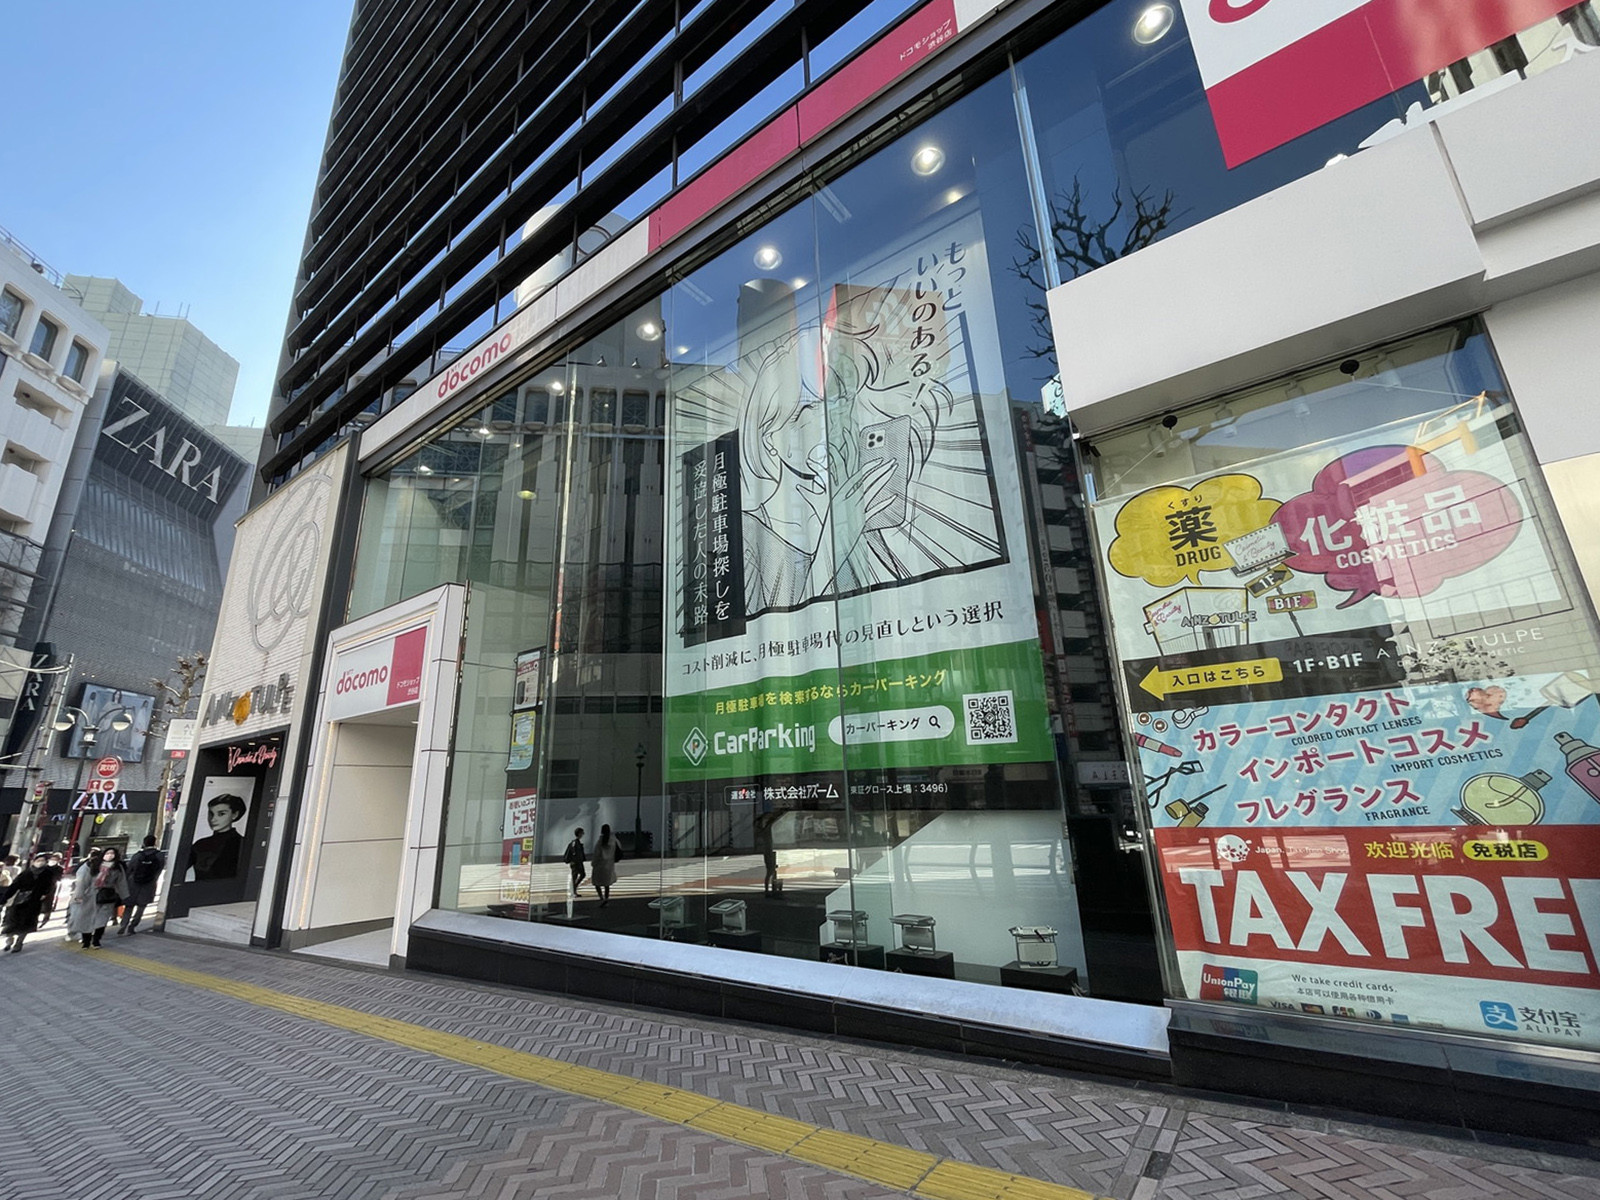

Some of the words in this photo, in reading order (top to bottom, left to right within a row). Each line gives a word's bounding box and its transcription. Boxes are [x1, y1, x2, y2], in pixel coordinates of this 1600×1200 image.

[900, 18, 951, 61] ドコモショップ
[943, 242, 966, 311] もっと
[437, 333, 512, 398] docomo
[102, 396, 221, 504] ZARA
[1168, 494, 1203, 510] くすり
[1165, 505, 1218, 551] 薬
[1300, 484, 1482, 555] 化粧品
[693, 459, 708, 626] 妥協した人の末路
[711, 451, 730, 621] 月極駐車場探しを
[1175, 545, 1221, 567] DRUG
[1336, 533, 1458, 569] COSMETICS
[1259, 573, 1275, 589] 1F
[1273, 595, 1301, 610] B1F
[1181, 614, 1210, 628] AINZ
[1219, 609, 1258, 624] TULPE
[1466, 627, 1544, 648] TULPE
[20, 654, 49, 711] ZARA
[336, 665, 388, 695] docomo
[1172, 665, 1265, 687] 入口はこちら
[846, 717, 920, 735] カーパーキング
[1193, 692, 1410, 752] カラーコンタクト
[1291, 728, 1333, 746] COLORED
[1335, 723, 1379, 739] CONTACT
[1382, 716, 1422, 731] LENSES
[714, 722, 816, 753] CarParking
[1239, 721, 1489, 782] インポートコスメ
[1391, 758, 1434, 773] IMPORT
[1437, 748, 1503, 766] COSMETICS
[72, 791, 128, 810] ZARA
[763, 784, 839, 800] 株式会社アズーム
[1237, 780, 1420, 823] フレグランス
[1365, 805, 1431, 821] FRAGRANCE
[1364, 841, 1455, 859] 欢迎光临
[1471, 842, 1538, 859] 免税店
[1179, 868, 1371, 957] TAX
[1203, 972, 1255, 993] UnionPay
[1292, 974, 1307, 983] We
[1310, 976, 1331, 986] take
[1333, 979, 1363, 990] credit
[1366, 982, 1398, 993] cards.
[1270, 1001, 1295, 1010] VISA
[1518, 1007, 1581, 1029] 支付宝
[1525, 1024, 1582, 1037] ALIPAY
